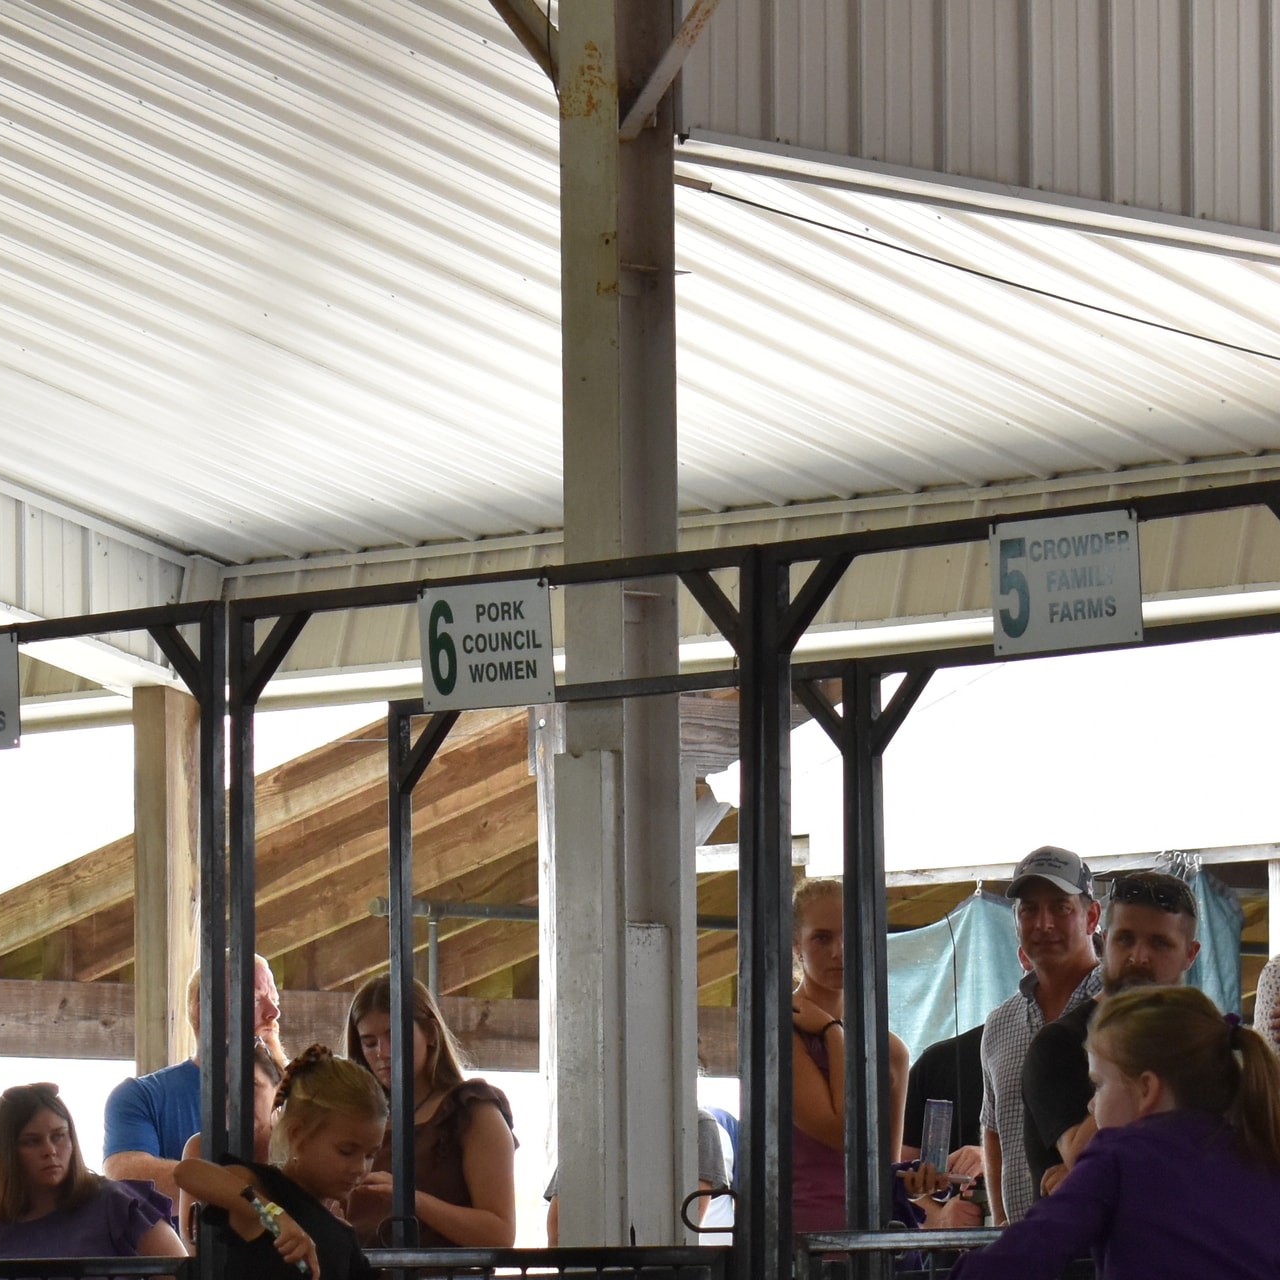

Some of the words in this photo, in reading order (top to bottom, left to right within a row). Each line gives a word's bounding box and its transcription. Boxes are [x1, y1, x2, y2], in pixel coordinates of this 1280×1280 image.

[999, 537, 1031, 639] 5
[475, 600, 525, 623] PORK
[1048, 595, 1118, 623] FARMS
[428, 599, 458, 696] 6
[462, 629, 543, 655] COUNCIL
[468, 659, 538, 683] WOMEN
